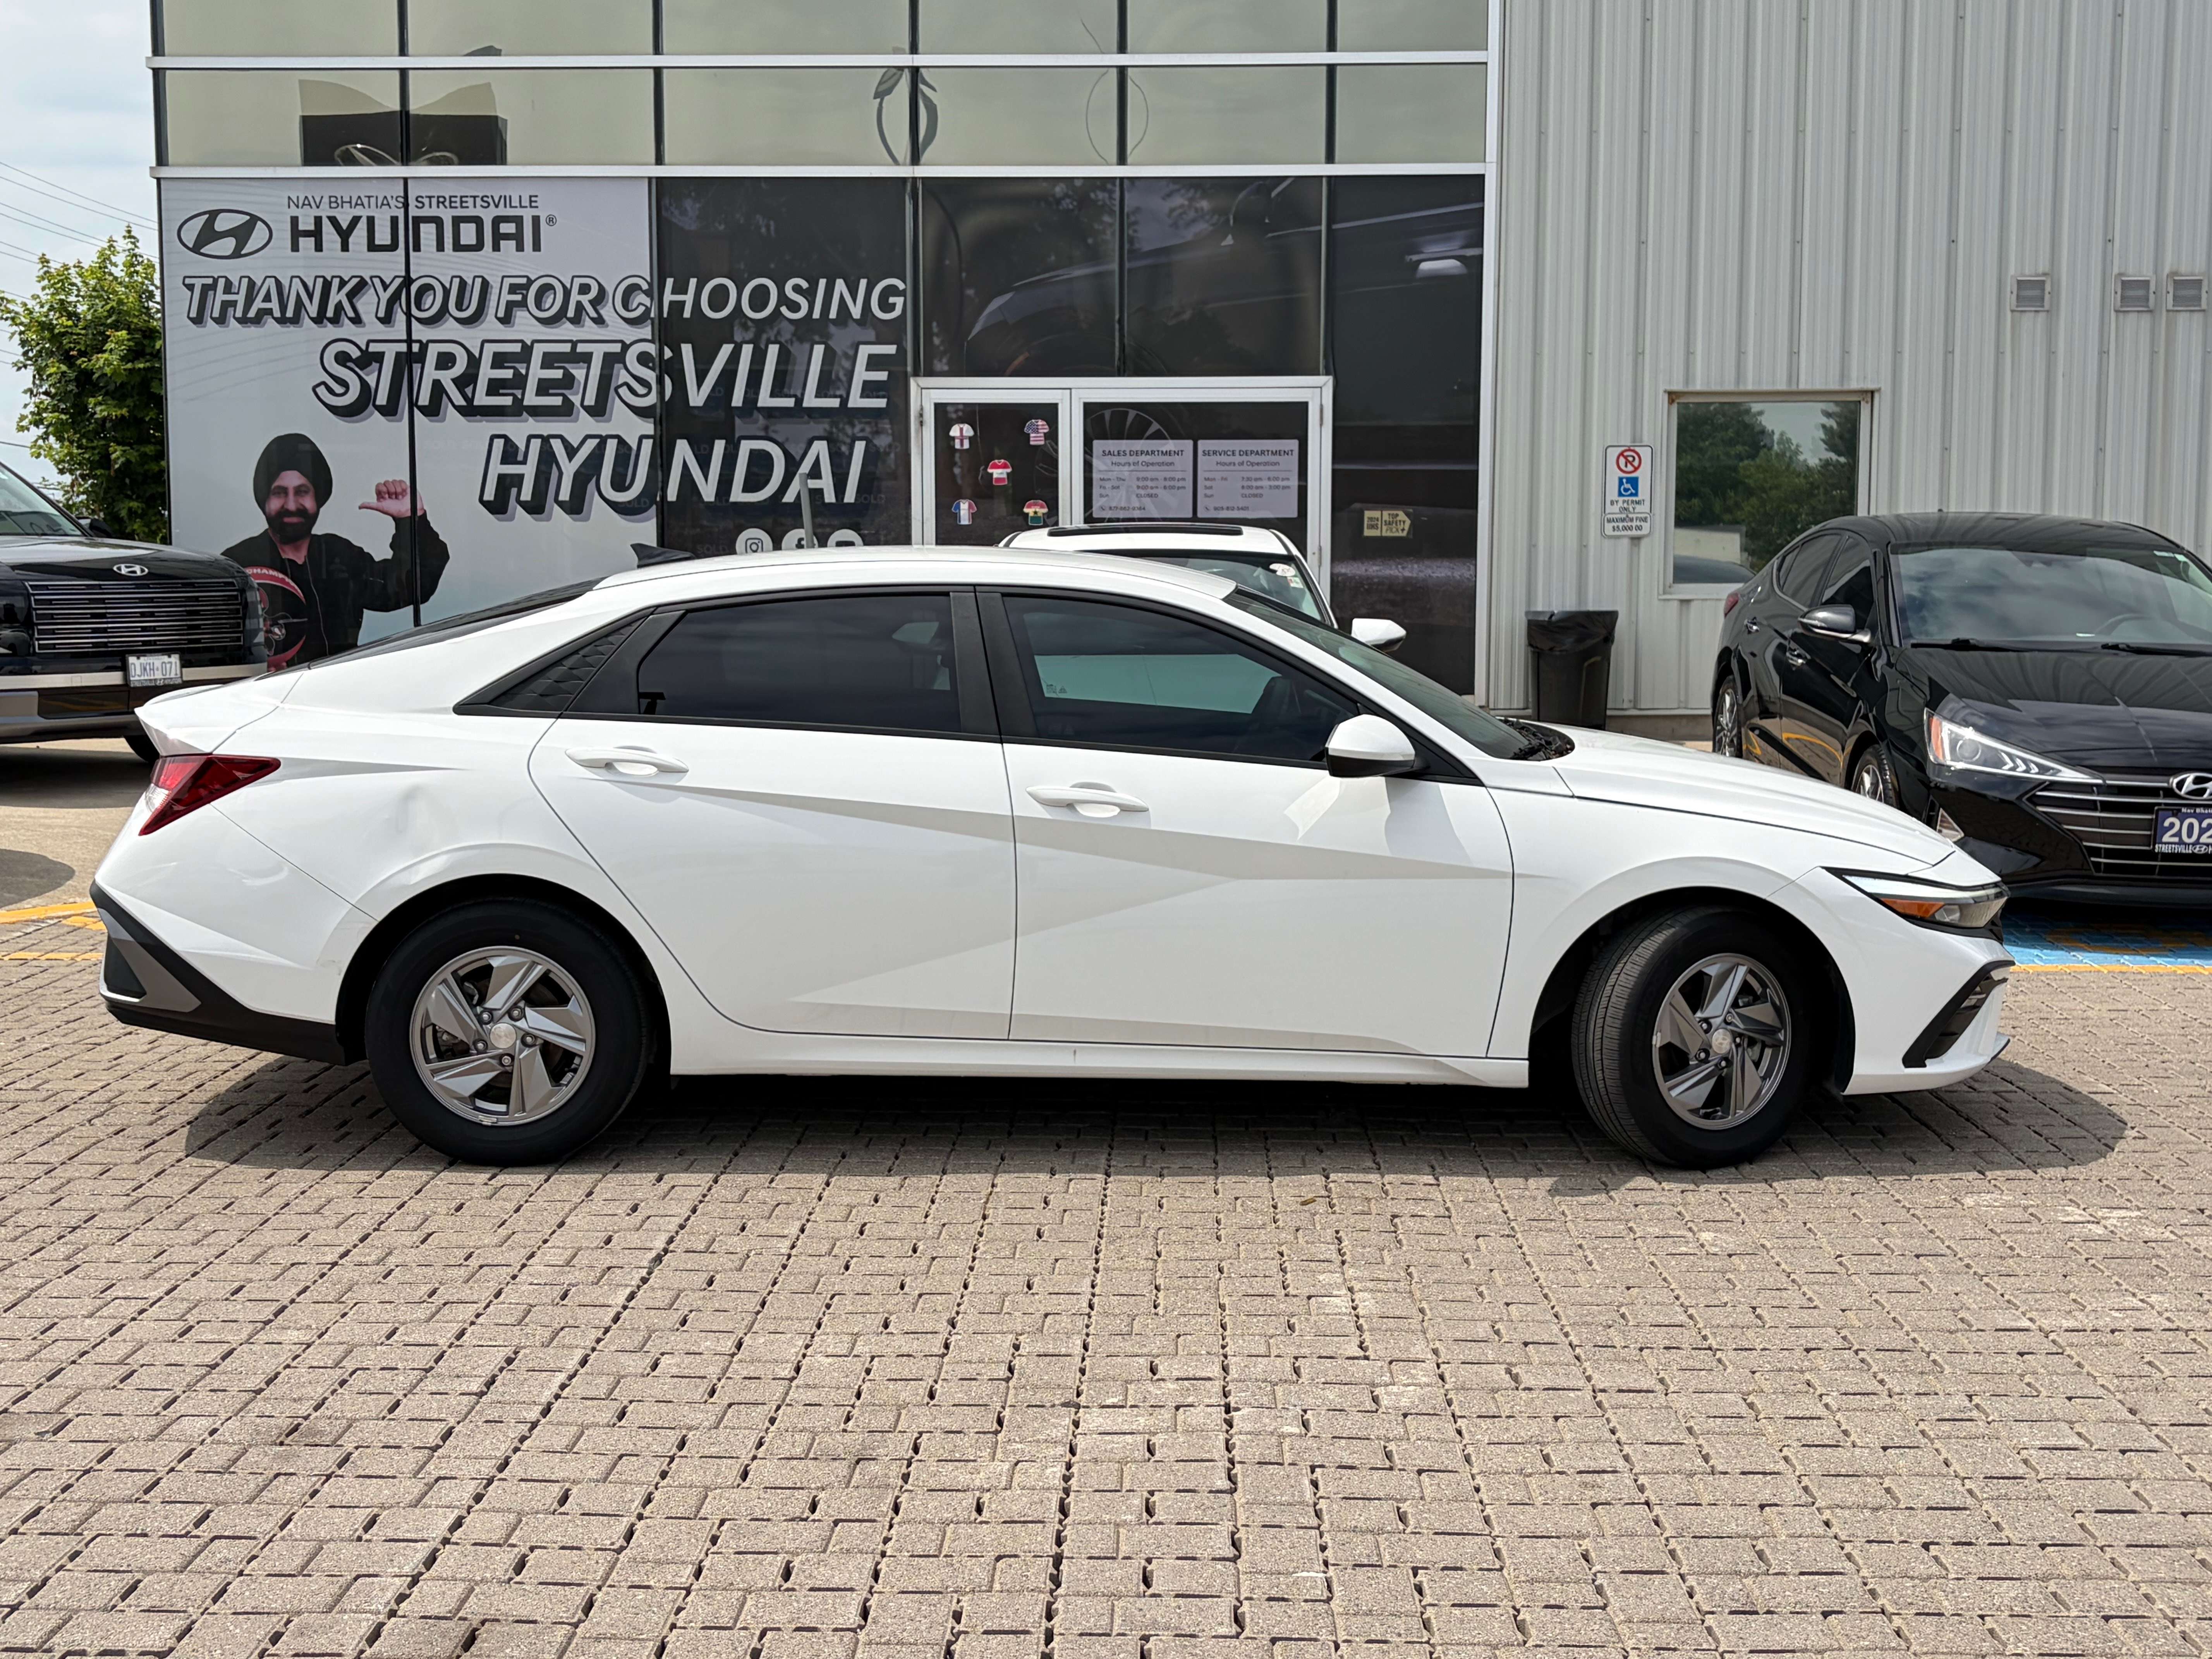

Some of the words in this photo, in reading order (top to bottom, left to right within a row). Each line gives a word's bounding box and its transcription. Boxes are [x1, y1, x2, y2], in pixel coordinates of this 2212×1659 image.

[288, 196, 323, 209] NAV
[329, 195, 407, 209] BHATIA'S
[414, 195, 539, 209] STREETSVILLE
[290, 215, 541, 252] HYUNDAI
[182, 275, 368, 325] THANK
[371, 275, 492, 326] YOU
[495, 274, 605, 326] FOR
[612, 275, 907, 322] CHOOSING
[311, 338, 898, 413] STREETSVILLE
[479, 434, 867, 510] HYUNDAI
[161, 661, 178, 677] 071
[2155, 843, 2192, 854] STREETSVILLE
